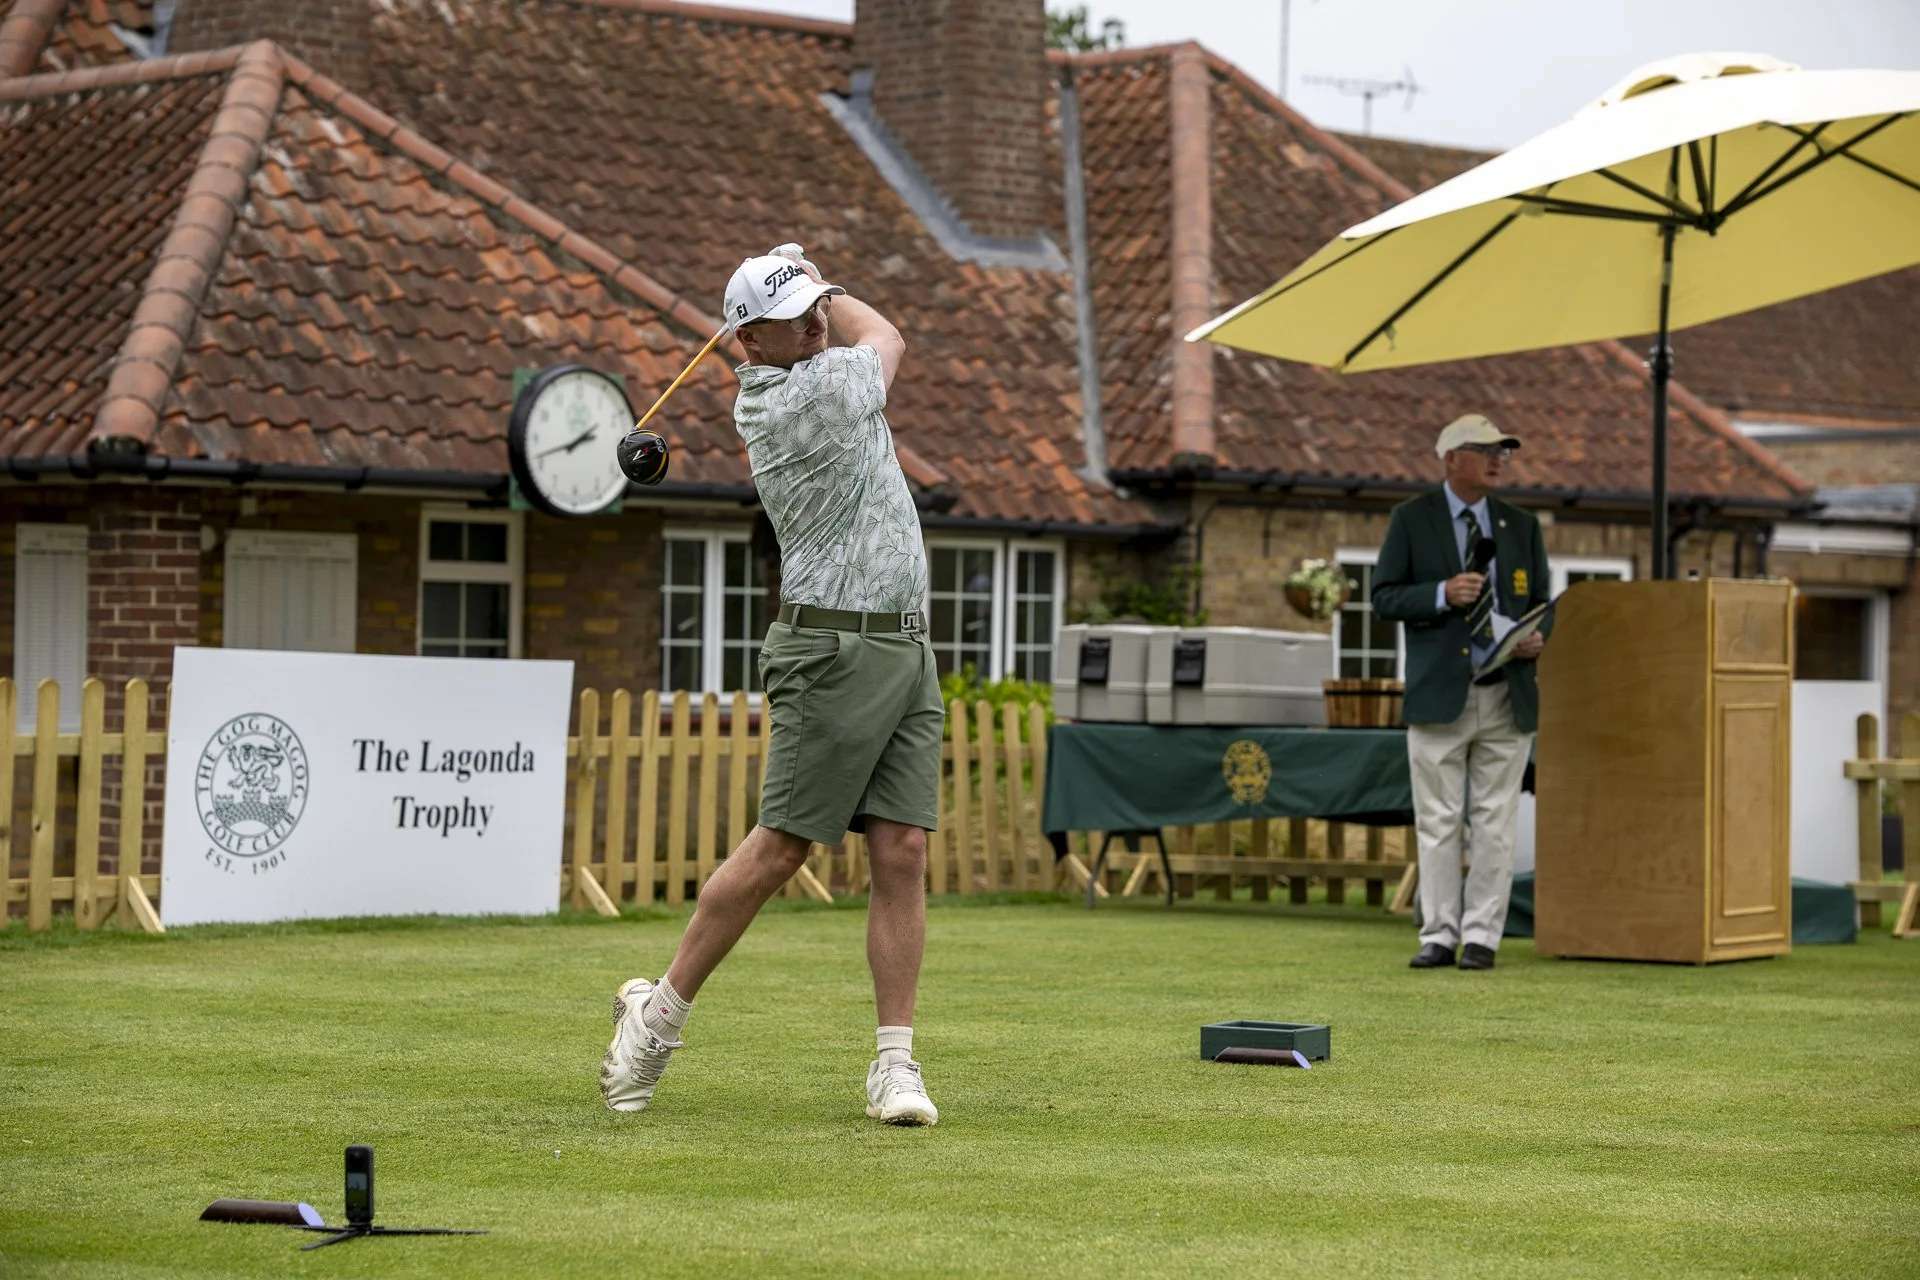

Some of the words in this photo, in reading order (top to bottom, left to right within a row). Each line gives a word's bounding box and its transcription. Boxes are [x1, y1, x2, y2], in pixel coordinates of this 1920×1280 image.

[764, 264, 809, 297] Titl
[736, 303, 749, 319] FJ
[198, 753, 216, 796] THE
[217, 717, 261, 746] GOG
[267, 721, 306, 799] MAGOG
[352, 738, 410, 773] The
[418, 740, 535, 783] Lagonda
[203, 810, 246, 853] GOLF
[252, 810, 296, 852] CLUB
[392, 795, 494, 838] Trophy
[252, 849, 287, 876] 1901
